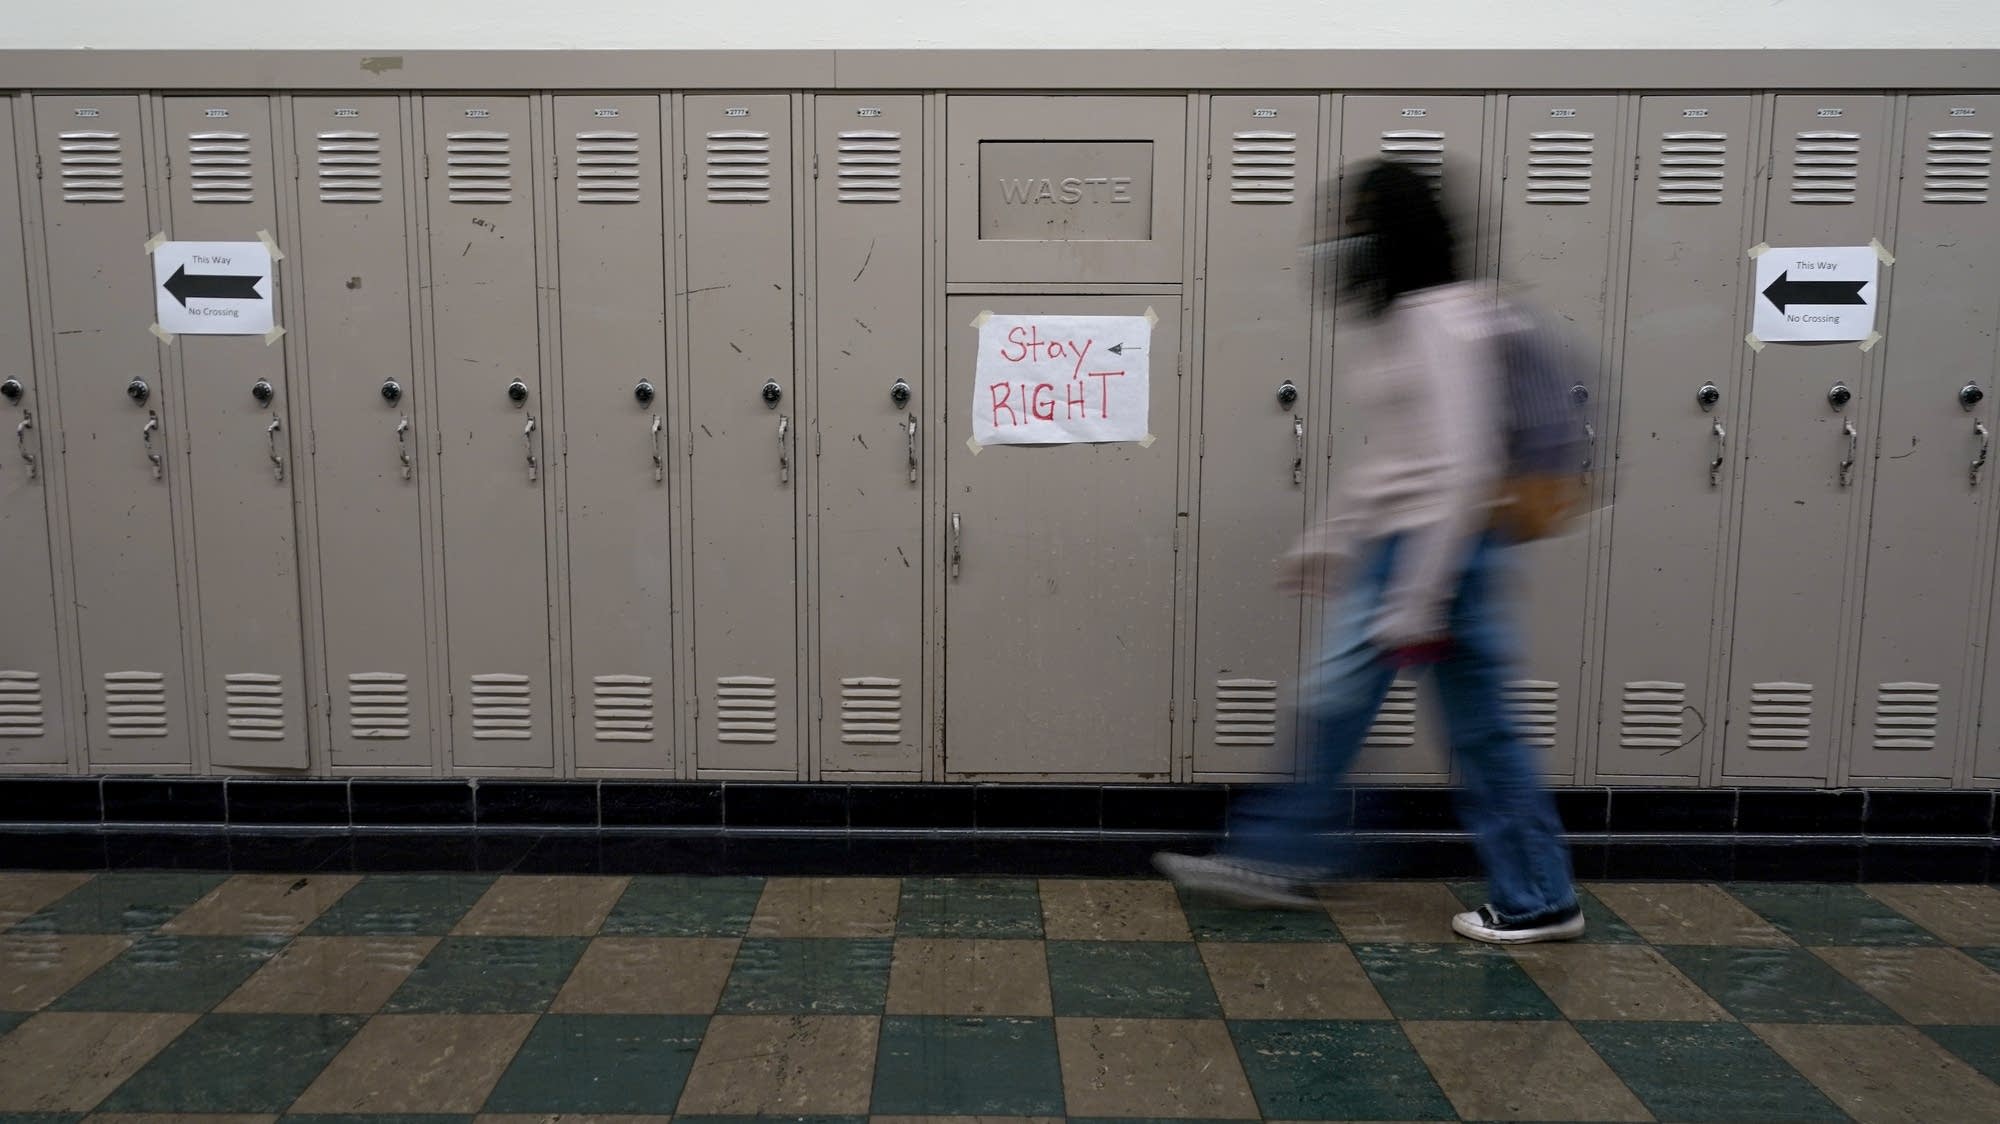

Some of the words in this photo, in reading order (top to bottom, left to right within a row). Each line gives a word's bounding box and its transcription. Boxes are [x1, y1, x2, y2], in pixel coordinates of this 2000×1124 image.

[1000, 177, 1131, 205] WASTE
[192, 255, 210, 264] This
[212, 256, 231, 266] Way
[1796, 261, 1815, 270] This
[1817, 261, 1838, 271] Way
[188, 308, 201, 316] No
[203, 307, 239, 318] Crossing
[1787, 314, 1800, 323] No
[1802, 314, 1840, 325] Crossing
[1001, 325, 1092, 380] Stay
[990, 371, 1125, 427] RIGHT
